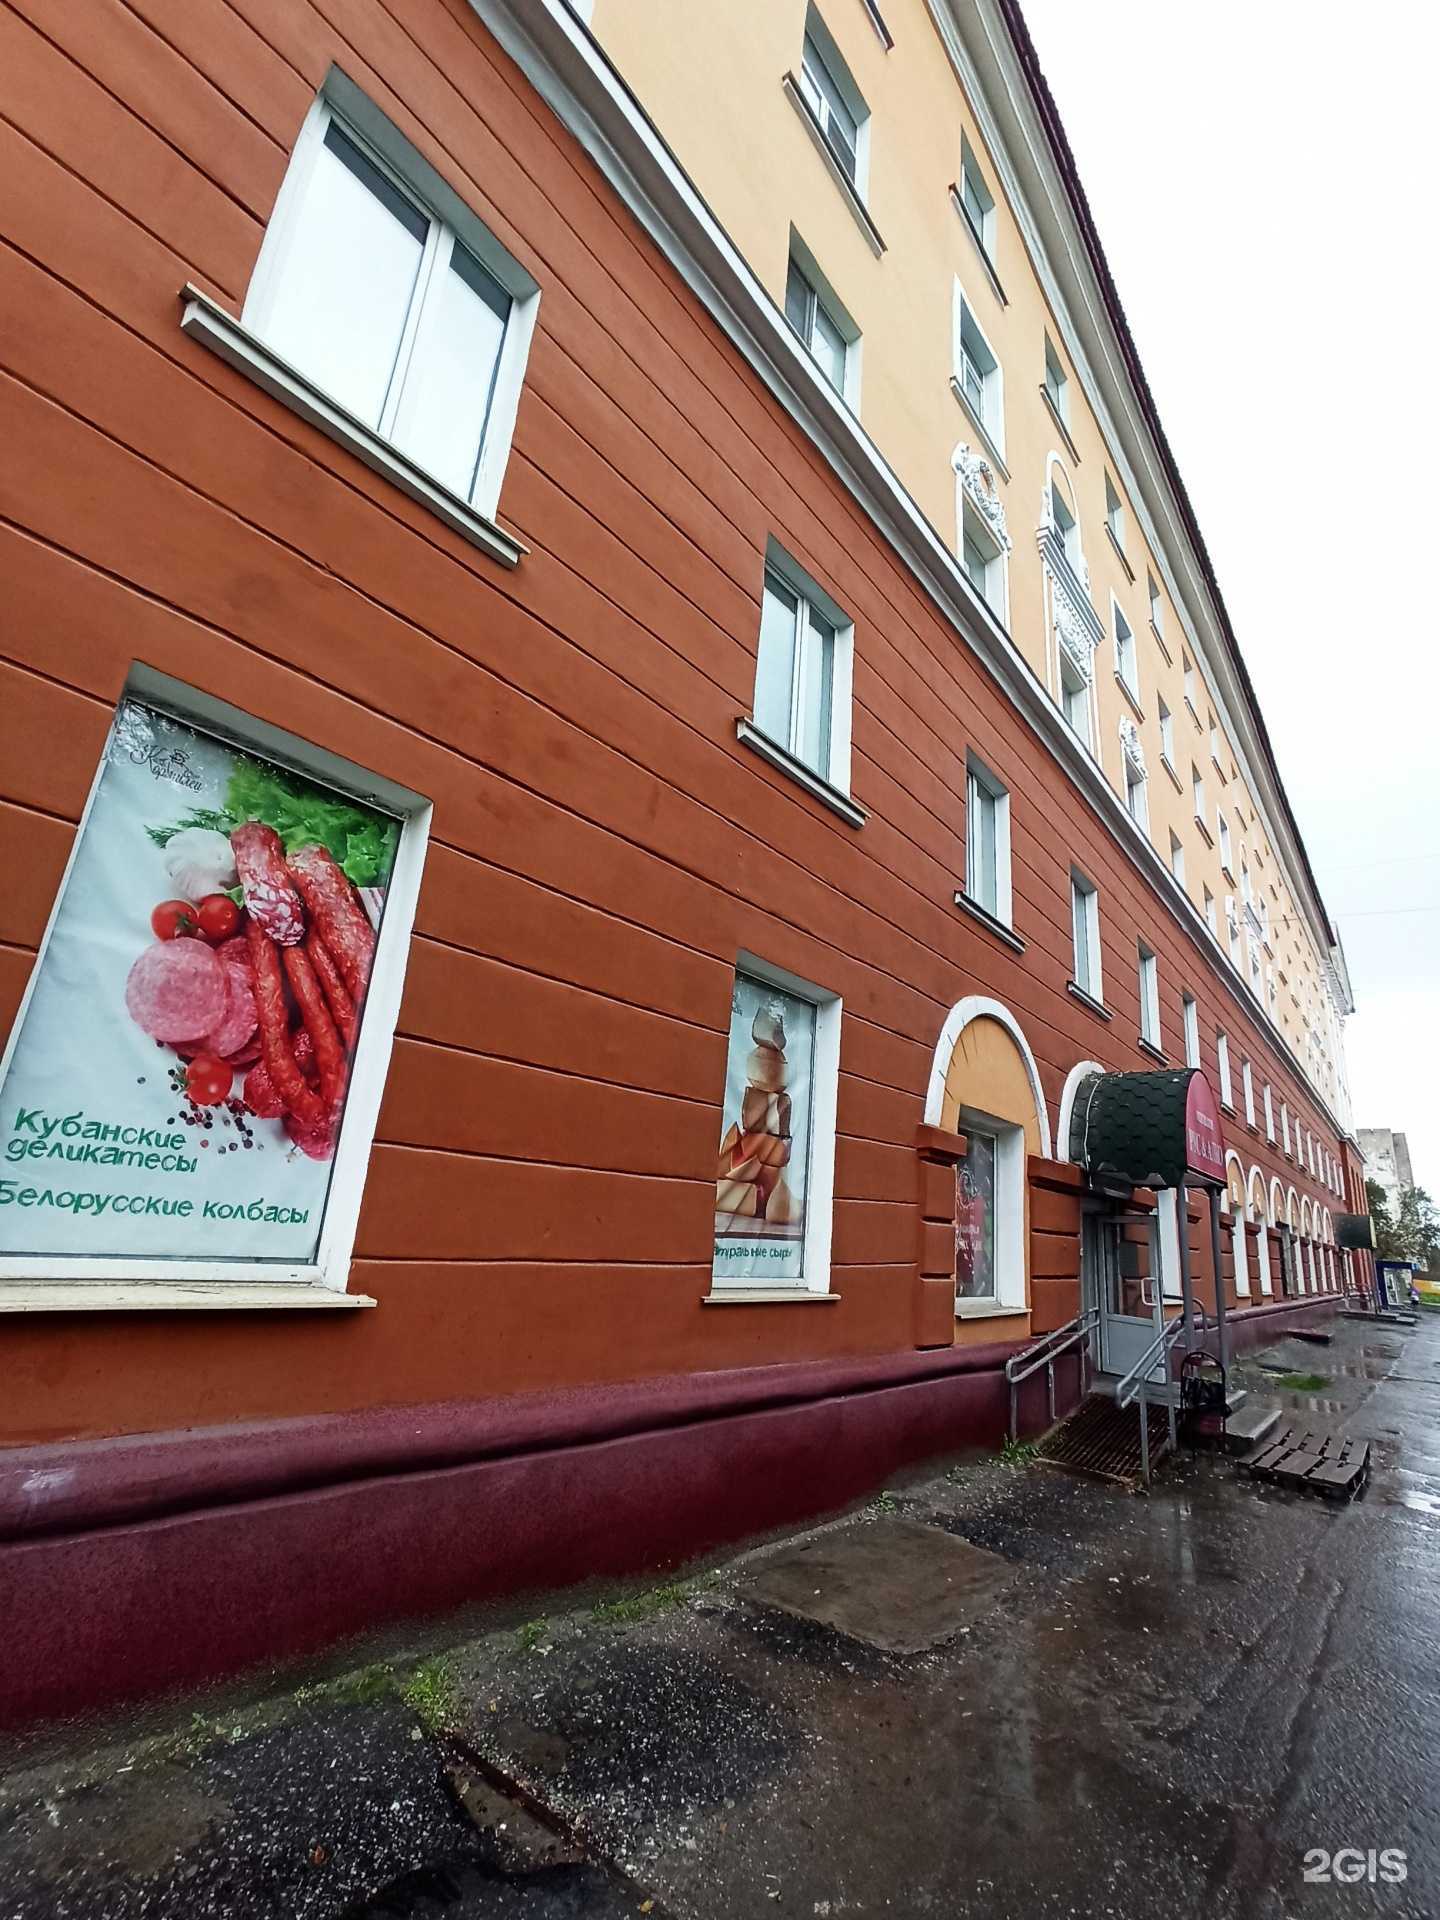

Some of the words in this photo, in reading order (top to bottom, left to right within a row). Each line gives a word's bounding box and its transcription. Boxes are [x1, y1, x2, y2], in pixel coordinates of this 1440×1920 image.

[14, 1108, 187, 1151] Кубанские
[5, 1137, 199, 1174] деликатесы
[0, 1180, 195, 1218] Белорусские
[203, 1197, 310, 1225] колбасы
